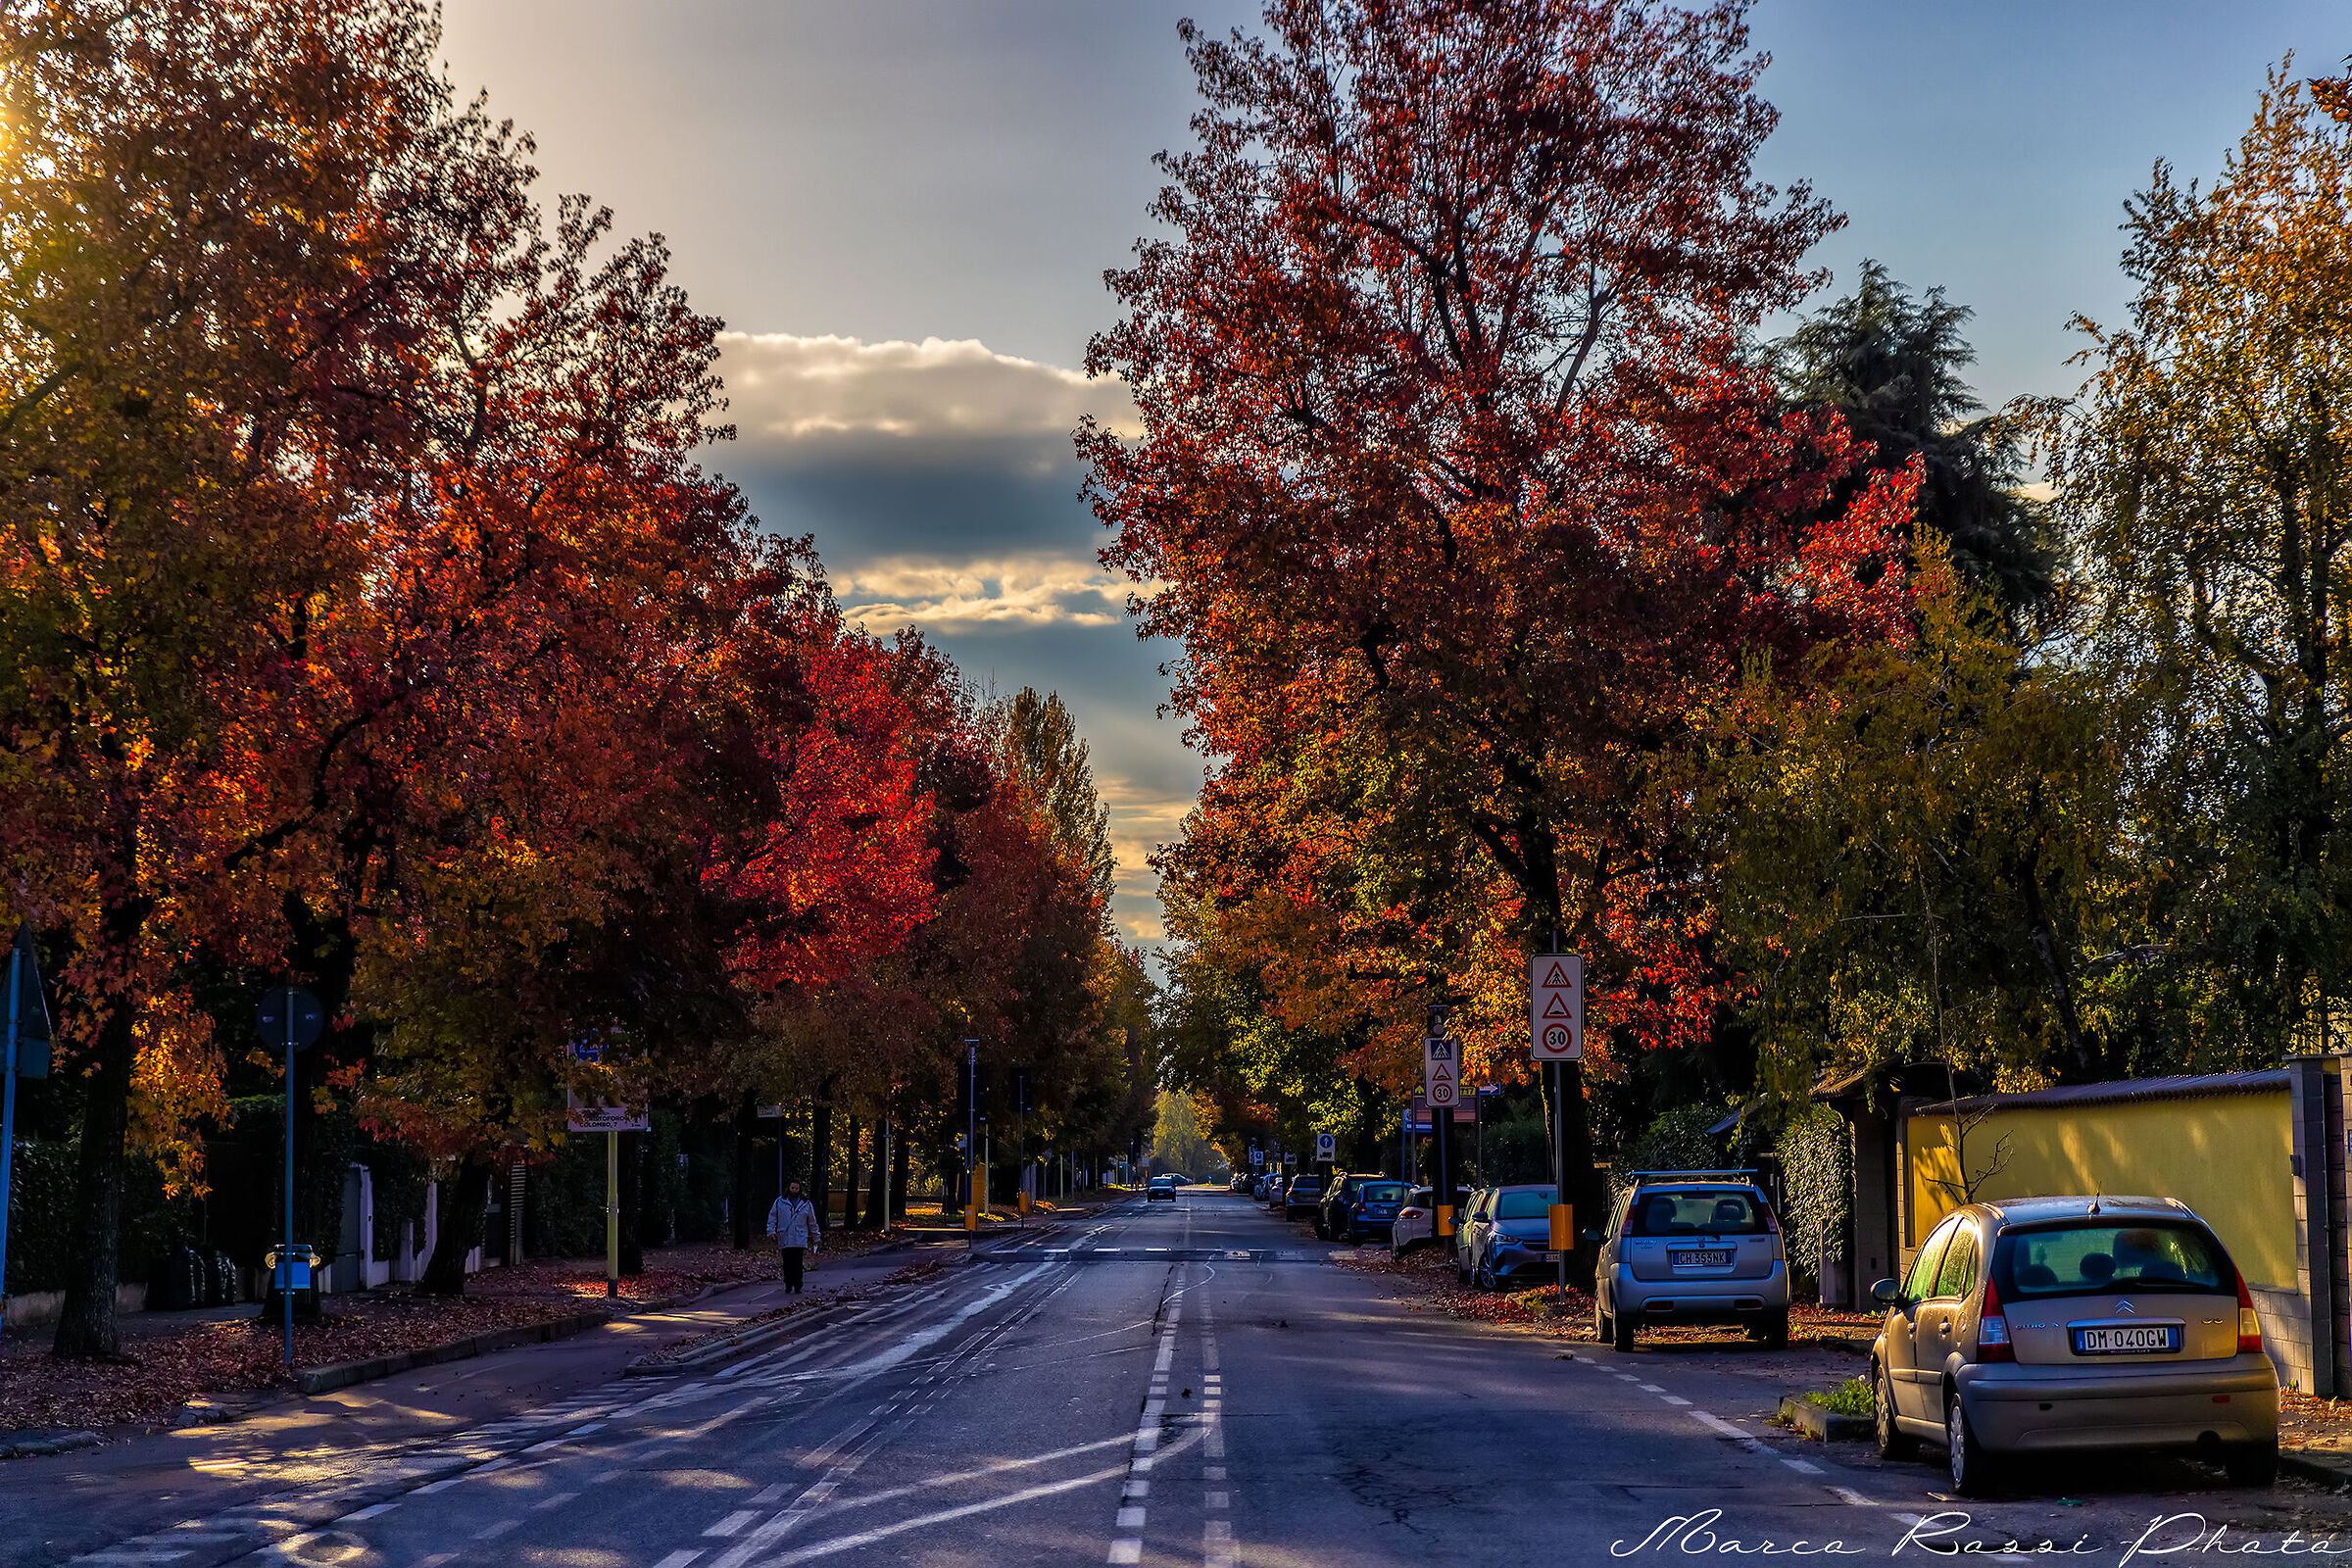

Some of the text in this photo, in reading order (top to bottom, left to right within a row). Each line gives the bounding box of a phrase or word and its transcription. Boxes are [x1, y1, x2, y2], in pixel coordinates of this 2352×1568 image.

[1548, 1031, 1566, 1046] 30
[1437, 1088, 1448, 1098] 30
[1680, 1252, 1725, 1263] CH 353NK
[2086, 1329, 2167, 1348] DM 040GW
